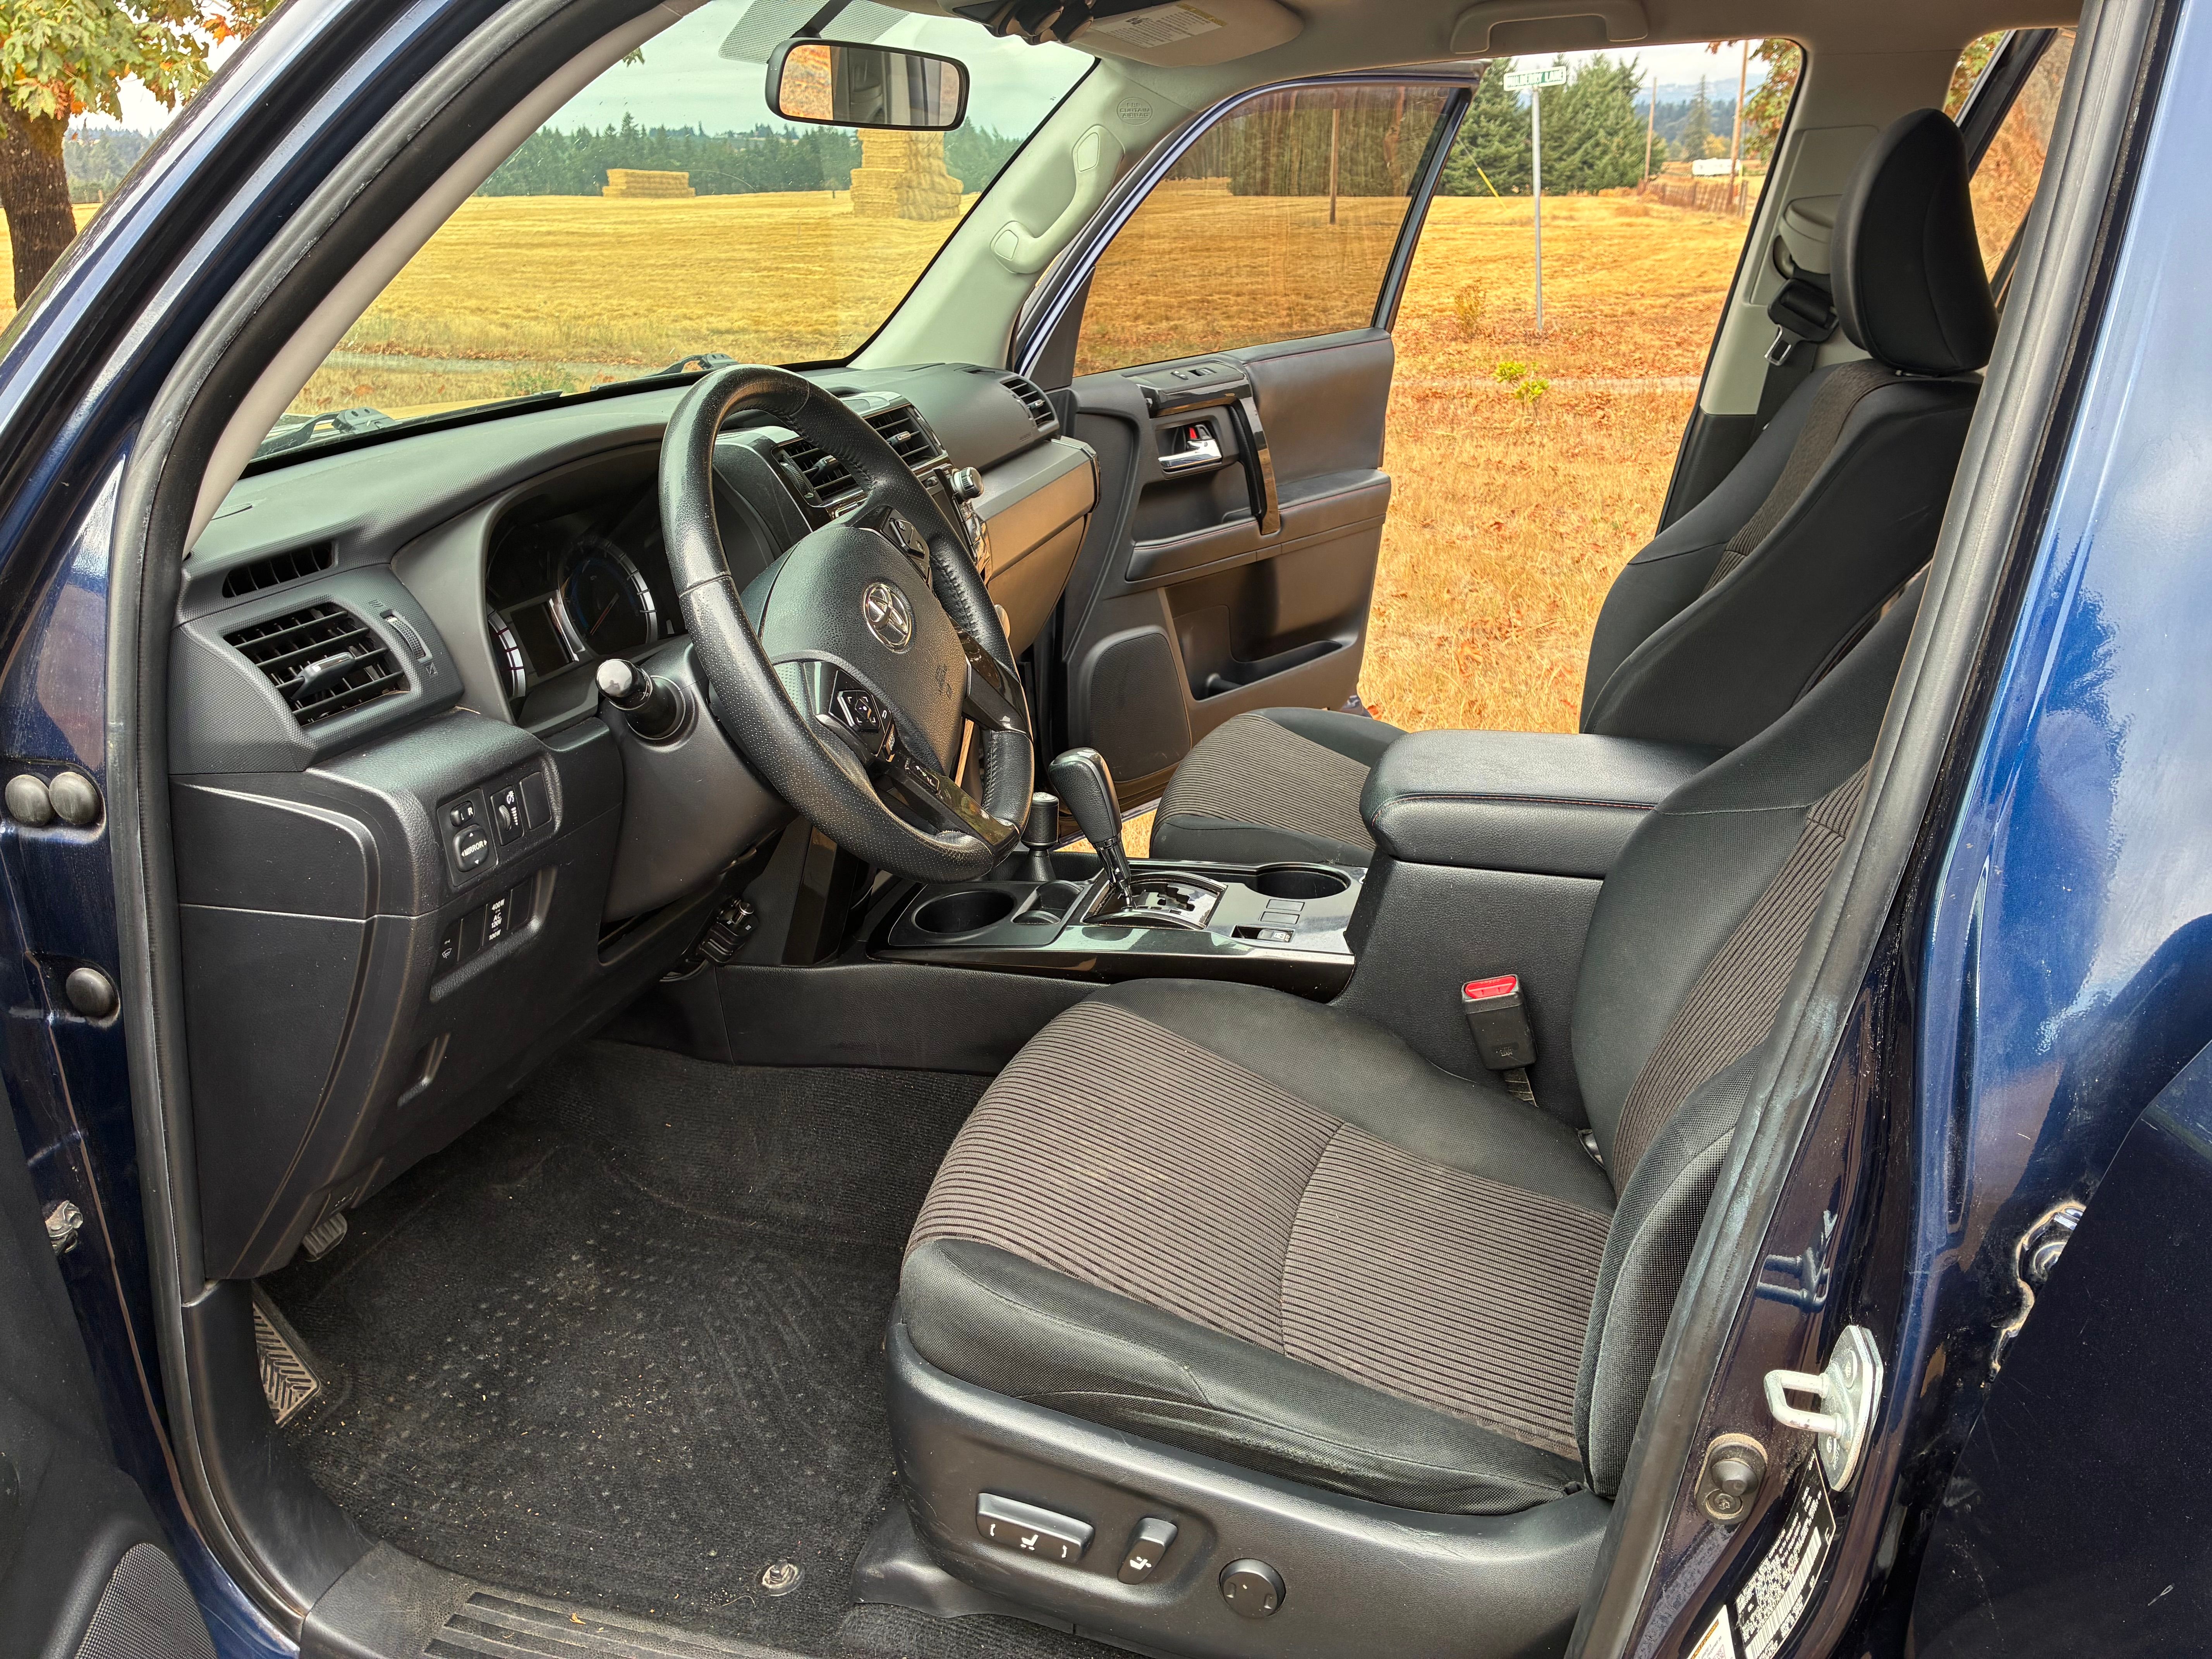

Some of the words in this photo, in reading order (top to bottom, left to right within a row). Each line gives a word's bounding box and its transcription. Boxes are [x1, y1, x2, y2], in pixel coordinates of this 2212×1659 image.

[467, 807, 473, 816] R
[464, 841, 484, 856] MIRROR
[491, 898, 505, 910] 400W
[491, 917, 502, 929] 120V
[493, 912, 501, 922] AC
[489, 929, 501, 941] 100W
